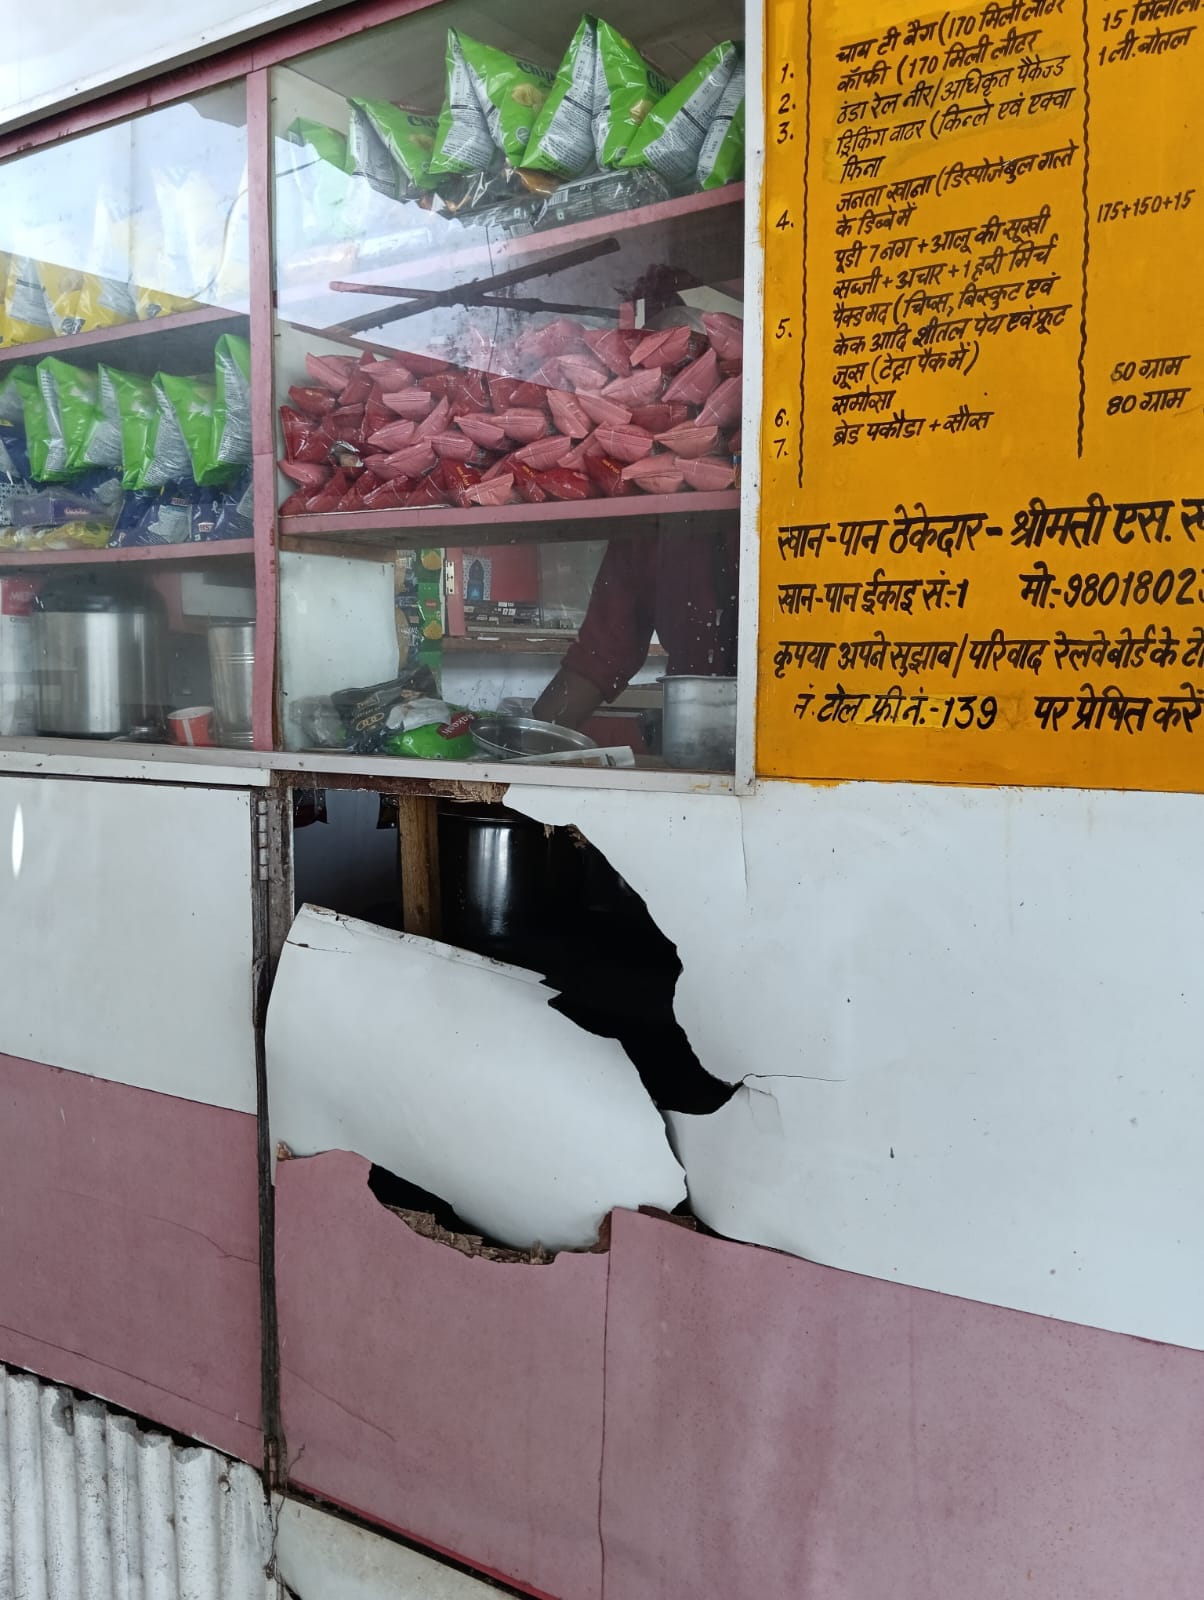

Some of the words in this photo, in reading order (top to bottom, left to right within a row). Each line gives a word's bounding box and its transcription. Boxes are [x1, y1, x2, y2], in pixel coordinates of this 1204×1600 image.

[1102, 9, 1128, 32] 15
[836, 39, 877, 63] चाय
[877, 26, 901, 55] टी
[903, 19, 937, 47] बैग
[938, 11, 976, 46] (170
[1137, 26, 1197, 55] बोतल
[782, 63, 794, 84] 1.
[836, 60, 891, 92] कॉफी
[897, 55, 938, 85] (170
[942, 34, 993, 70] मिली
[991, 26, 1042, 60] लीटर
[778, 93, 796, 114] 2.
[836, 101, 868, 124] ठंडा
[871, 92, 902, 118] रेल
[889, 120, 926, 142] वाटर
[998, 92, 1026, 120] एवं
[1028, 87, 1076, 115] एक्वा
[777, 121, 794, 144] 3.
[840, 155, 886, 184] फिना
[836, 184, 887, 212] जनता
[886, 175, 936, 201] खाना
[1097, 189, 1196, 223] 175+150+15
[776, 209, 794, 230] 4.
[835, 209, 856, 237] के
[896, 202, 917, 226] में
[975, 215, 1006, 245] की
[1003, 204, 1050, 242] सूखी
[833, 266, 882, 298] सब्जी
[896, 263, 947, 290] अचार
[972, 246, 1008, 281] हरी
[1009, 233, 1059, 272] मिर्च
[958, 282, 1024, 311] बिस्कुट
[1026, 272, 1061, 298] एवं
[776, 318, 792, 339] 5.
[833, 332, 866, 356] केक
[870, 322, 912, 352] आदि
[975, 311, 1008, 337] पेय
[1006, 304, 1037, 332] एवं
[832, 362, 869, 389] जूस
[918, 347, 947, 373] पैक
[1110, 361, 1136, 382] 50
[1139, 355, 1191, 379] ग्राम
[832, 384, 897, 415] समोसा
[1106, 395, 1137, 416] 80
[1139, 387, 1192, 412] ग्राम
[775, 408, 789, 427] 6.
[832, 419, 864, 447] ब्रेड
[773, 438, 789, 459] 7.
[1010, 492, 1112, 549] श्रीमती
[1113, 500, 1175, 544] एस.
[773, 640, 836, 678] कृपया
[838, 630, 891, 670] अपने
[1054, 630, 1111, 671] रेलवे
[1107, 624, 1157, 669] बोर्ड
[1149, 626, 1180, 668] के
[817, 682, 871, 724] टोल
[1034, 696, 1075, 731] पर
[1072, 683, 1153, 734] प्रेषित
